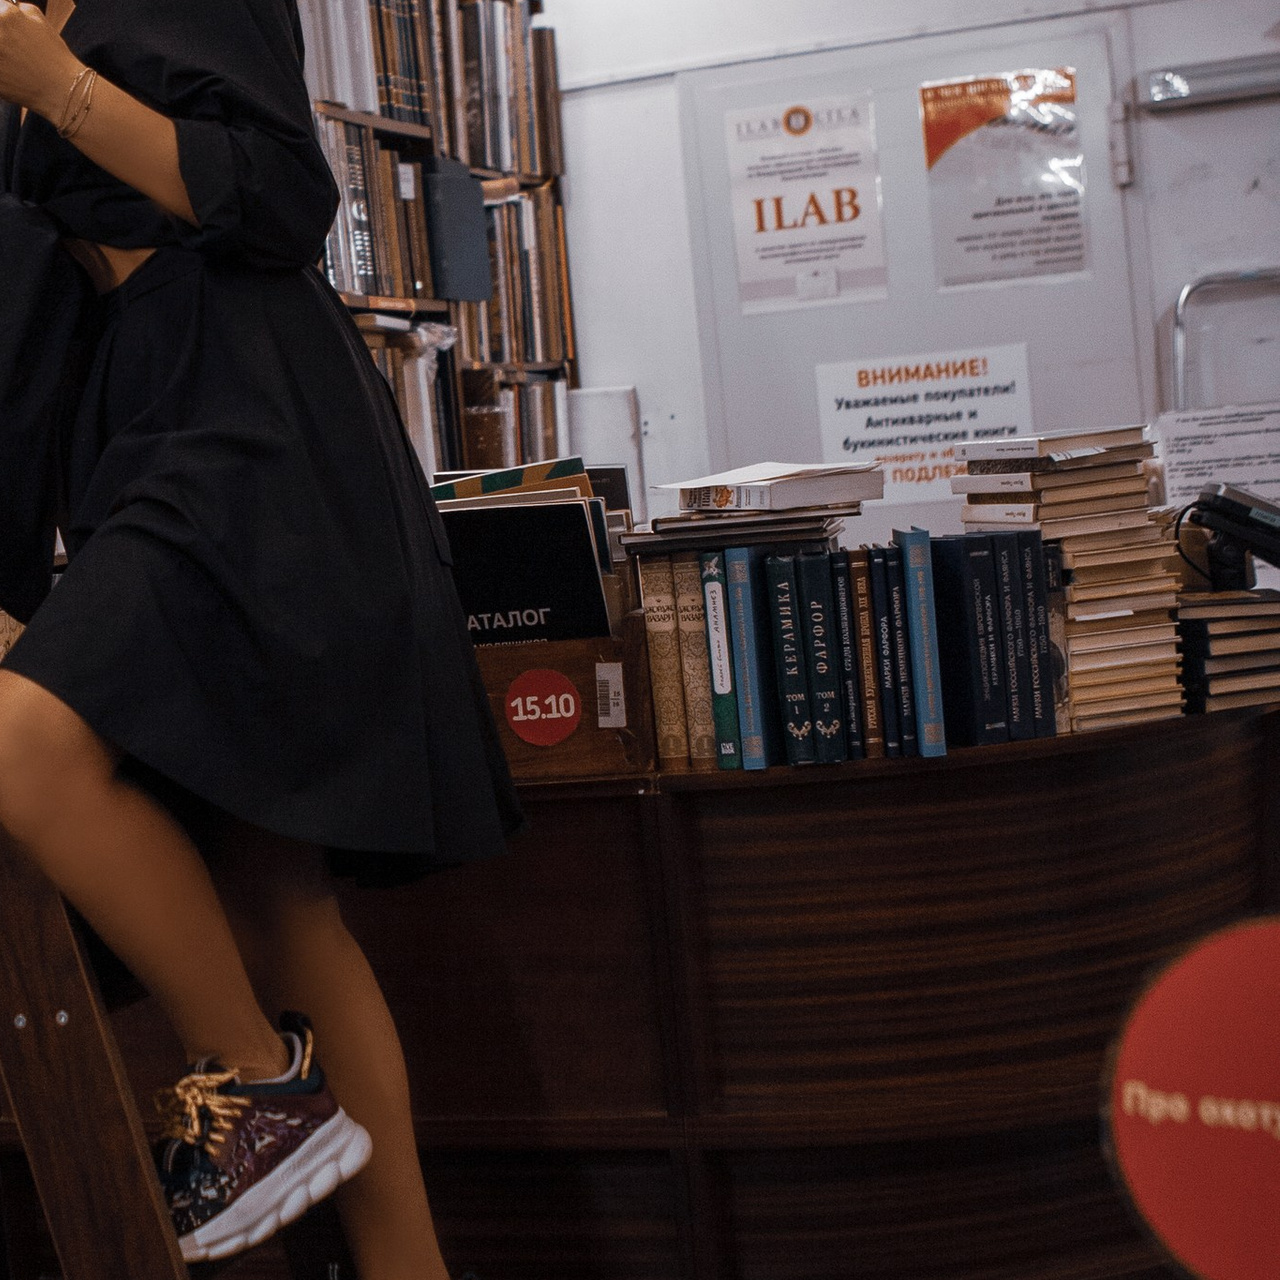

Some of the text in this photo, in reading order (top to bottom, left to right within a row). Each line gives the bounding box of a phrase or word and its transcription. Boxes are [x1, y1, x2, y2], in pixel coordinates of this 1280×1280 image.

[753, 187, 861, 234] ILAB
[856, 357, 988, 388] ВНИМАНИЕ!
[835, 381, 1015, 410] Уважаемые покупатели!
[865, 410, 978, 429] Антикварные и
[842, 426, 1017, 453] букинистические книги
[855, 576, 867, 594] ВЕКА
[467, 608, 550, 631] АТАЛОГ
[776, 581, 798, 676] КЕРАМИКА
[983, 594, 994, 632] ФАРФОРА
[809, 599, 828, 674] ФАРФОР
[1000, 549, 1019, 722] МАРКИ РОССИЙСКОГО ФАРФОРА ФАЯНСА
[1023, 546, 1043, 719] МАРКИ РОССИЙСКОГО ФАРФОРА ФАЯНСА
[878, 616, 893, 688] МАРКИ ФАРФОРА
[890, 585, 911, 715] МАРКИ НЕМЕЦКОГО ФАРФОРА
[510, 693, 575, 721] 15.10
[786, 693, 805, 702] ТОМ
[816, 691, 835, 713] ТОМ 2
